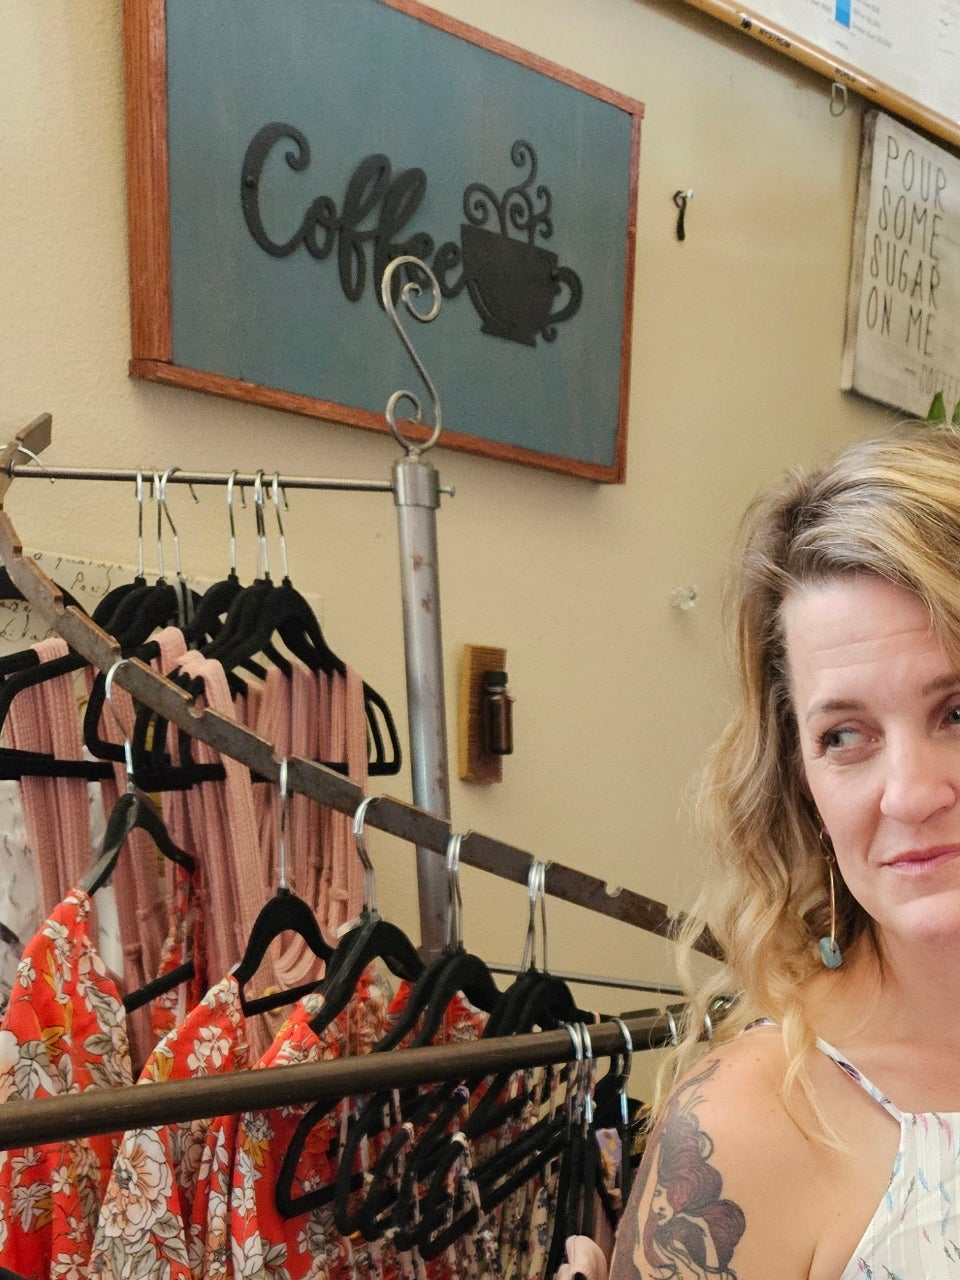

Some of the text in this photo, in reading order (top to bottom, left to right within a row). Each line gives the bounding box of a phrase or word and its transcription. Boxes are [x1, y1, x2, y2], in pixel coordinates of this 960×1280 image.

[884, 136, 946, 213] POUR
[241, 122, 466, 312] Coffee
[879, 185, 943, 262] SOME
[870, 234, 941, 310] SUGAR
[866, 286, 936, 356] ON ME
